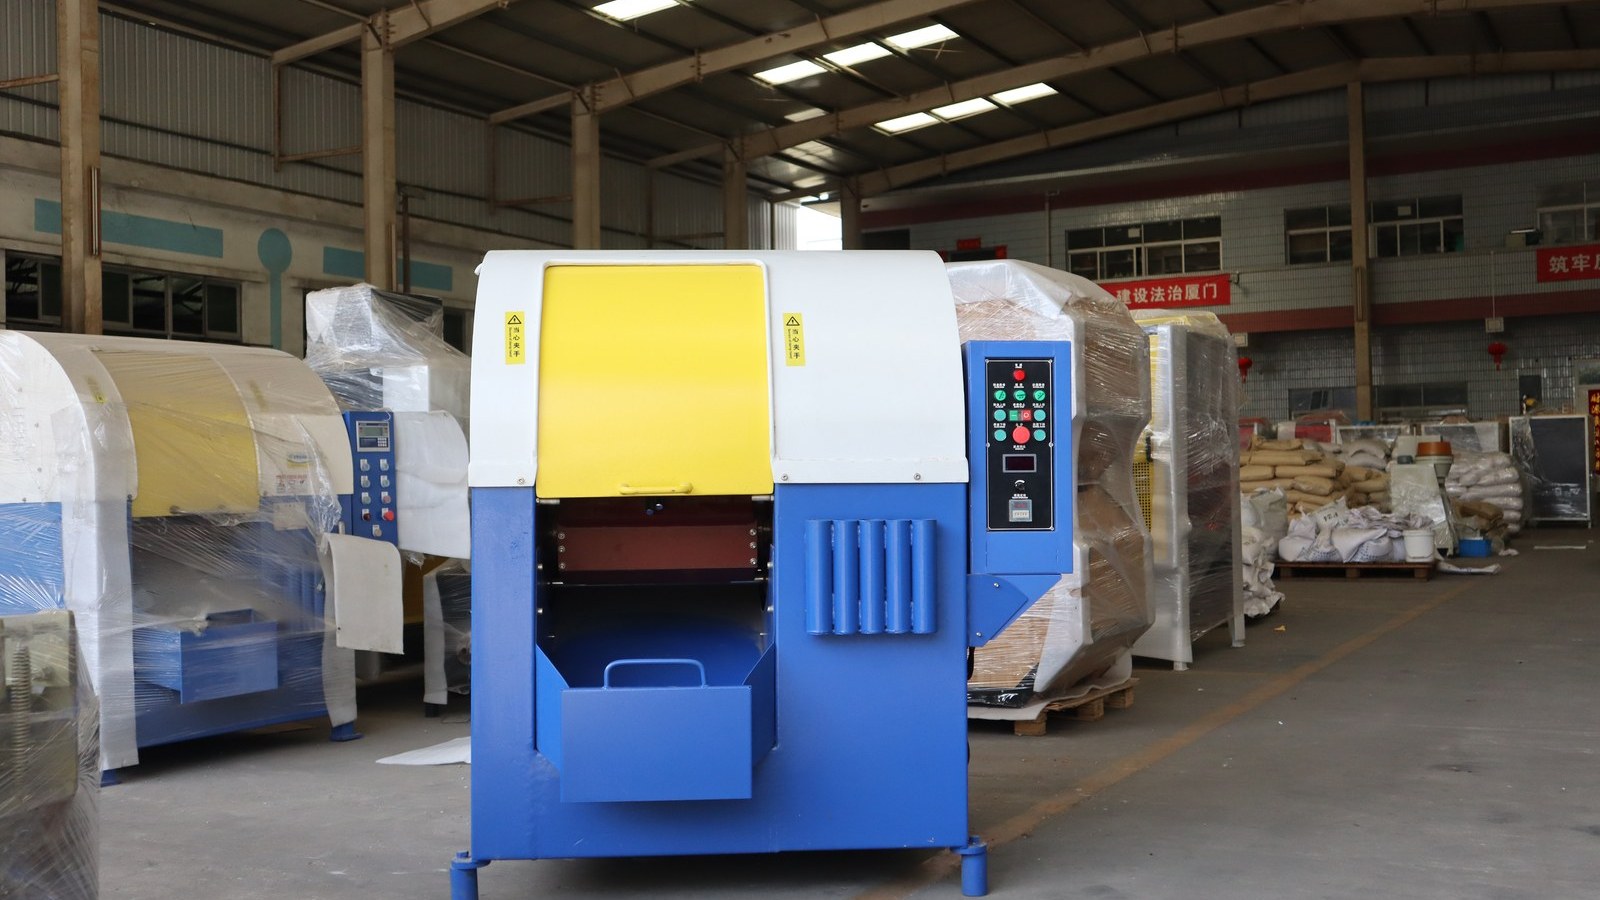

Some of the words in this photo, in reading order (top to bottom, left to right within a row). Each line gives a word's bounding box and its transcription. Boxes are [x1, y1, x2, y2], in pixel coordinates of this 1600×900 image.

[1116, 283, 1217, 304] 建设法治厦门
